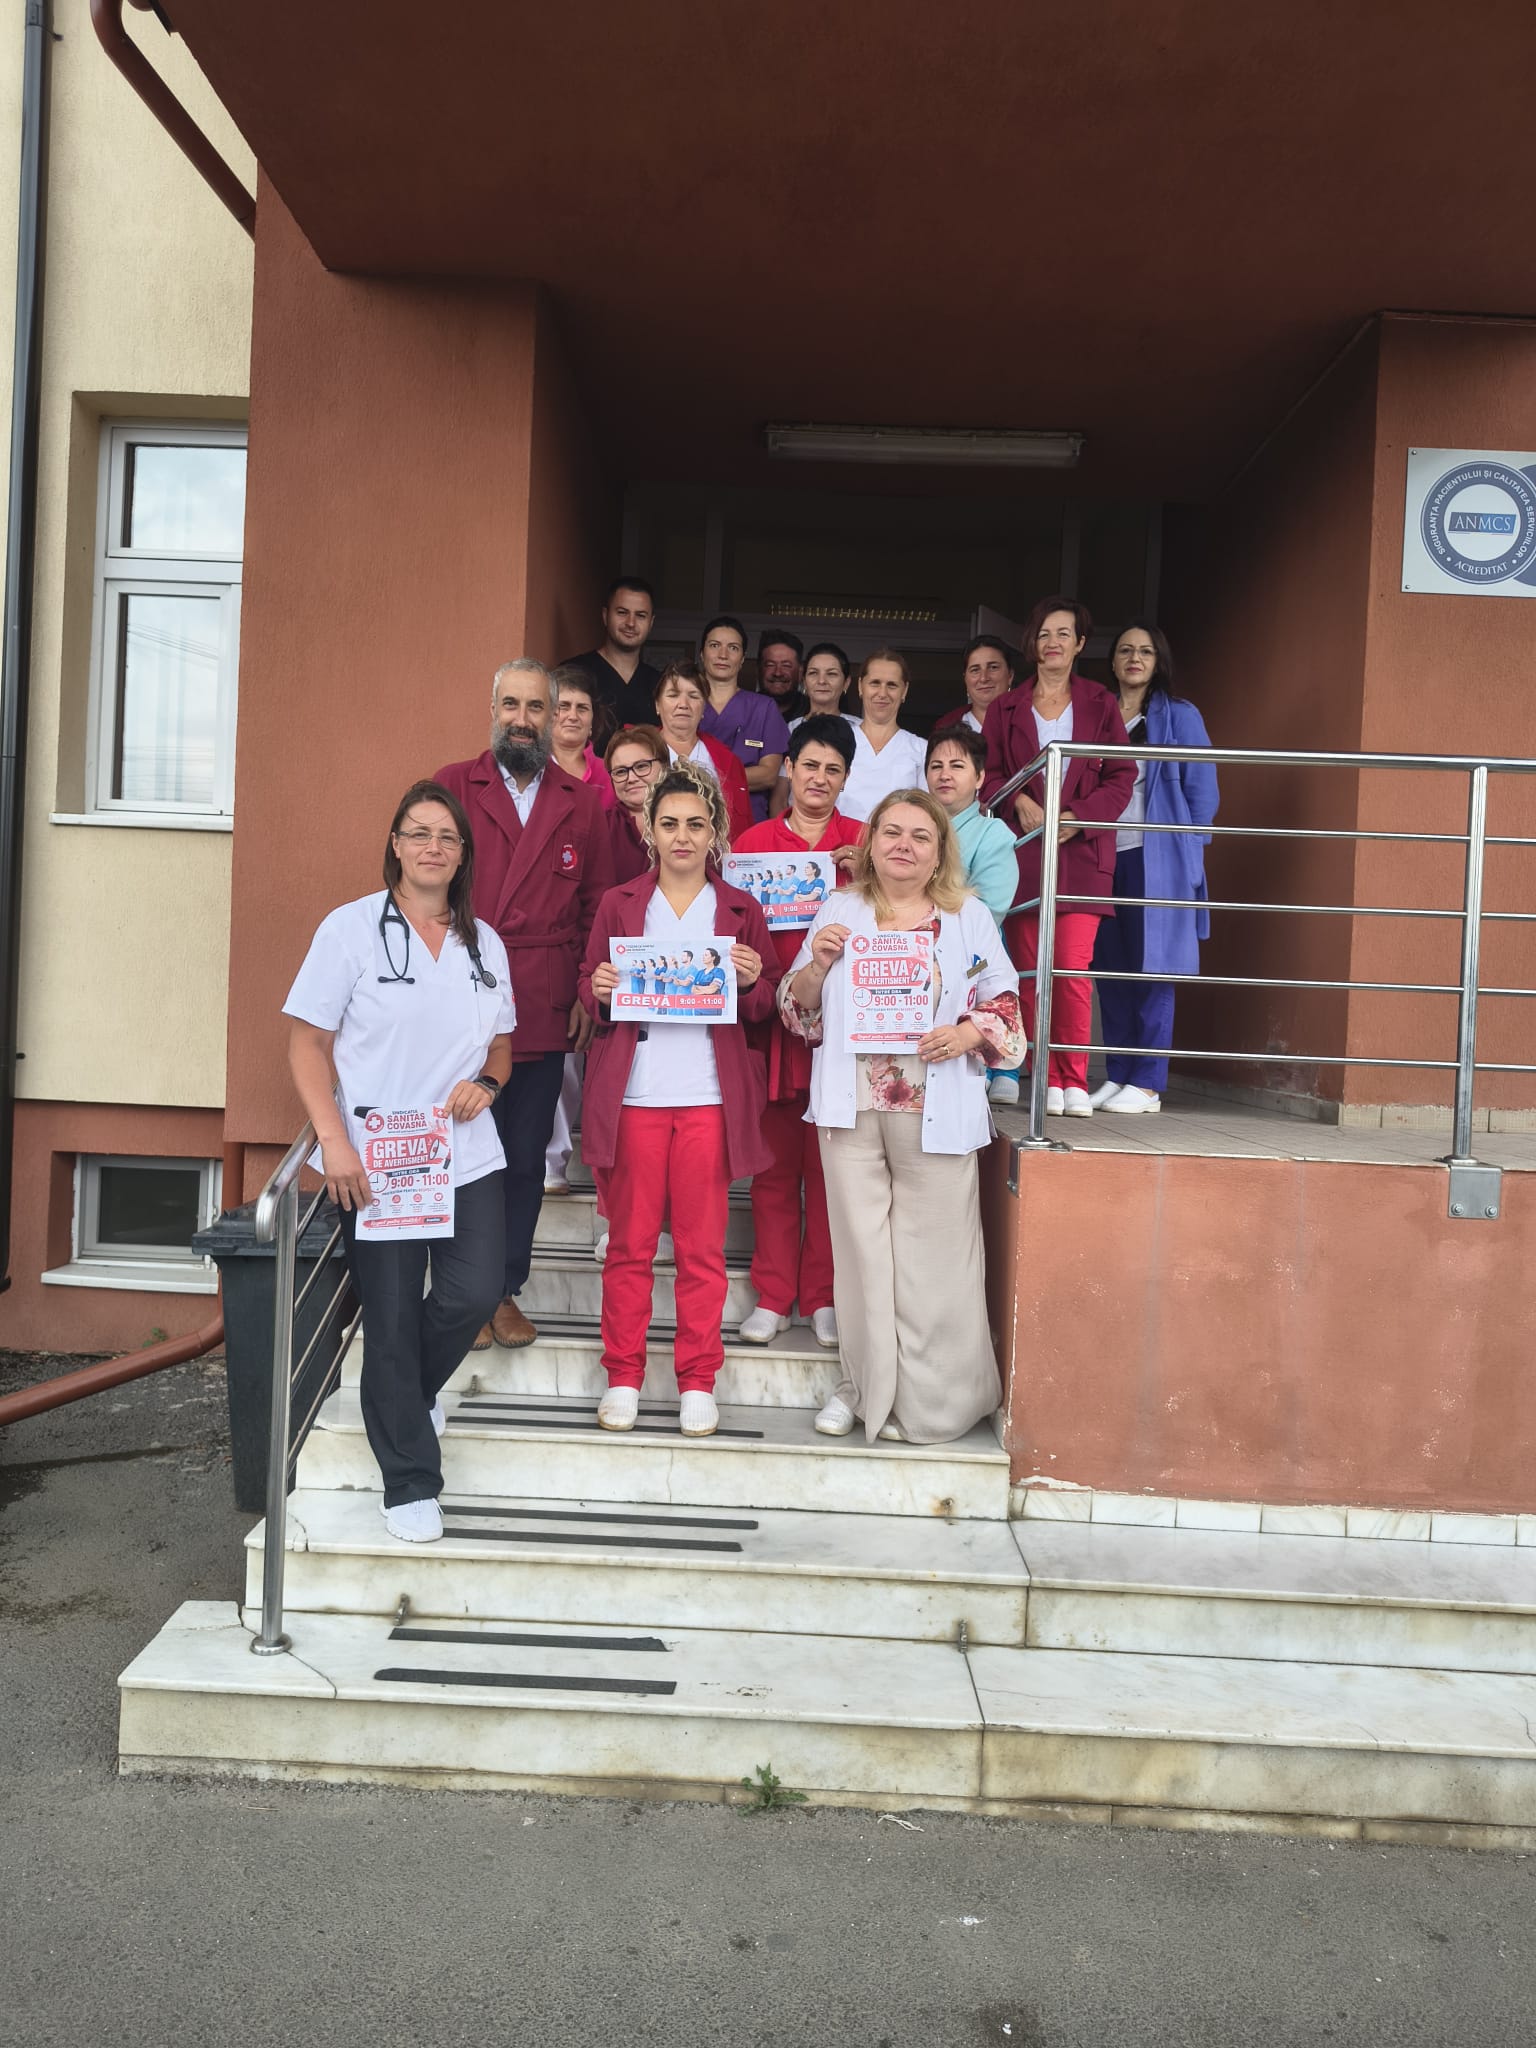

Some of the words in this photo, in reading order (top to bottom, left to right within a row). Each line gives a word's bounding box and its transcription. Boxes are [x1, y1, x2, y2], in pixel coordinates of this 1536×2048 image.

[1434, 469, 1482, 505] PACIENTULUI
[1493, 471, 1531, 506] CALITATEA
[1455, 514, 1511, 531] ANMCS
[1454, 561, 1508, 575] ACREDITAT
[871, 944, 909, 952] COVASNA
[872, 937, 908, 945] SANITAS
[858, 959, 909, 977] GREVA
[858, 977, 868, 985] DE
[868, 976, 910, 985] AVERTISMENT
[874, 995, 897, 1006] 9:00
[904, 995, 929, 1006] 11:00
[387, 1112, 426, 1122] SANITAS
[387, 1120, 427, 1130] COVASNA
[372, 1138, 428, 1160] GREVA
[373, 1159, 381, 1169] DE
[384, 1155, 429, 1168] AVERTISMENT
[391, 1175, 414, 1189] 9:00
[422, 1173, 450, 1186] 11:00
